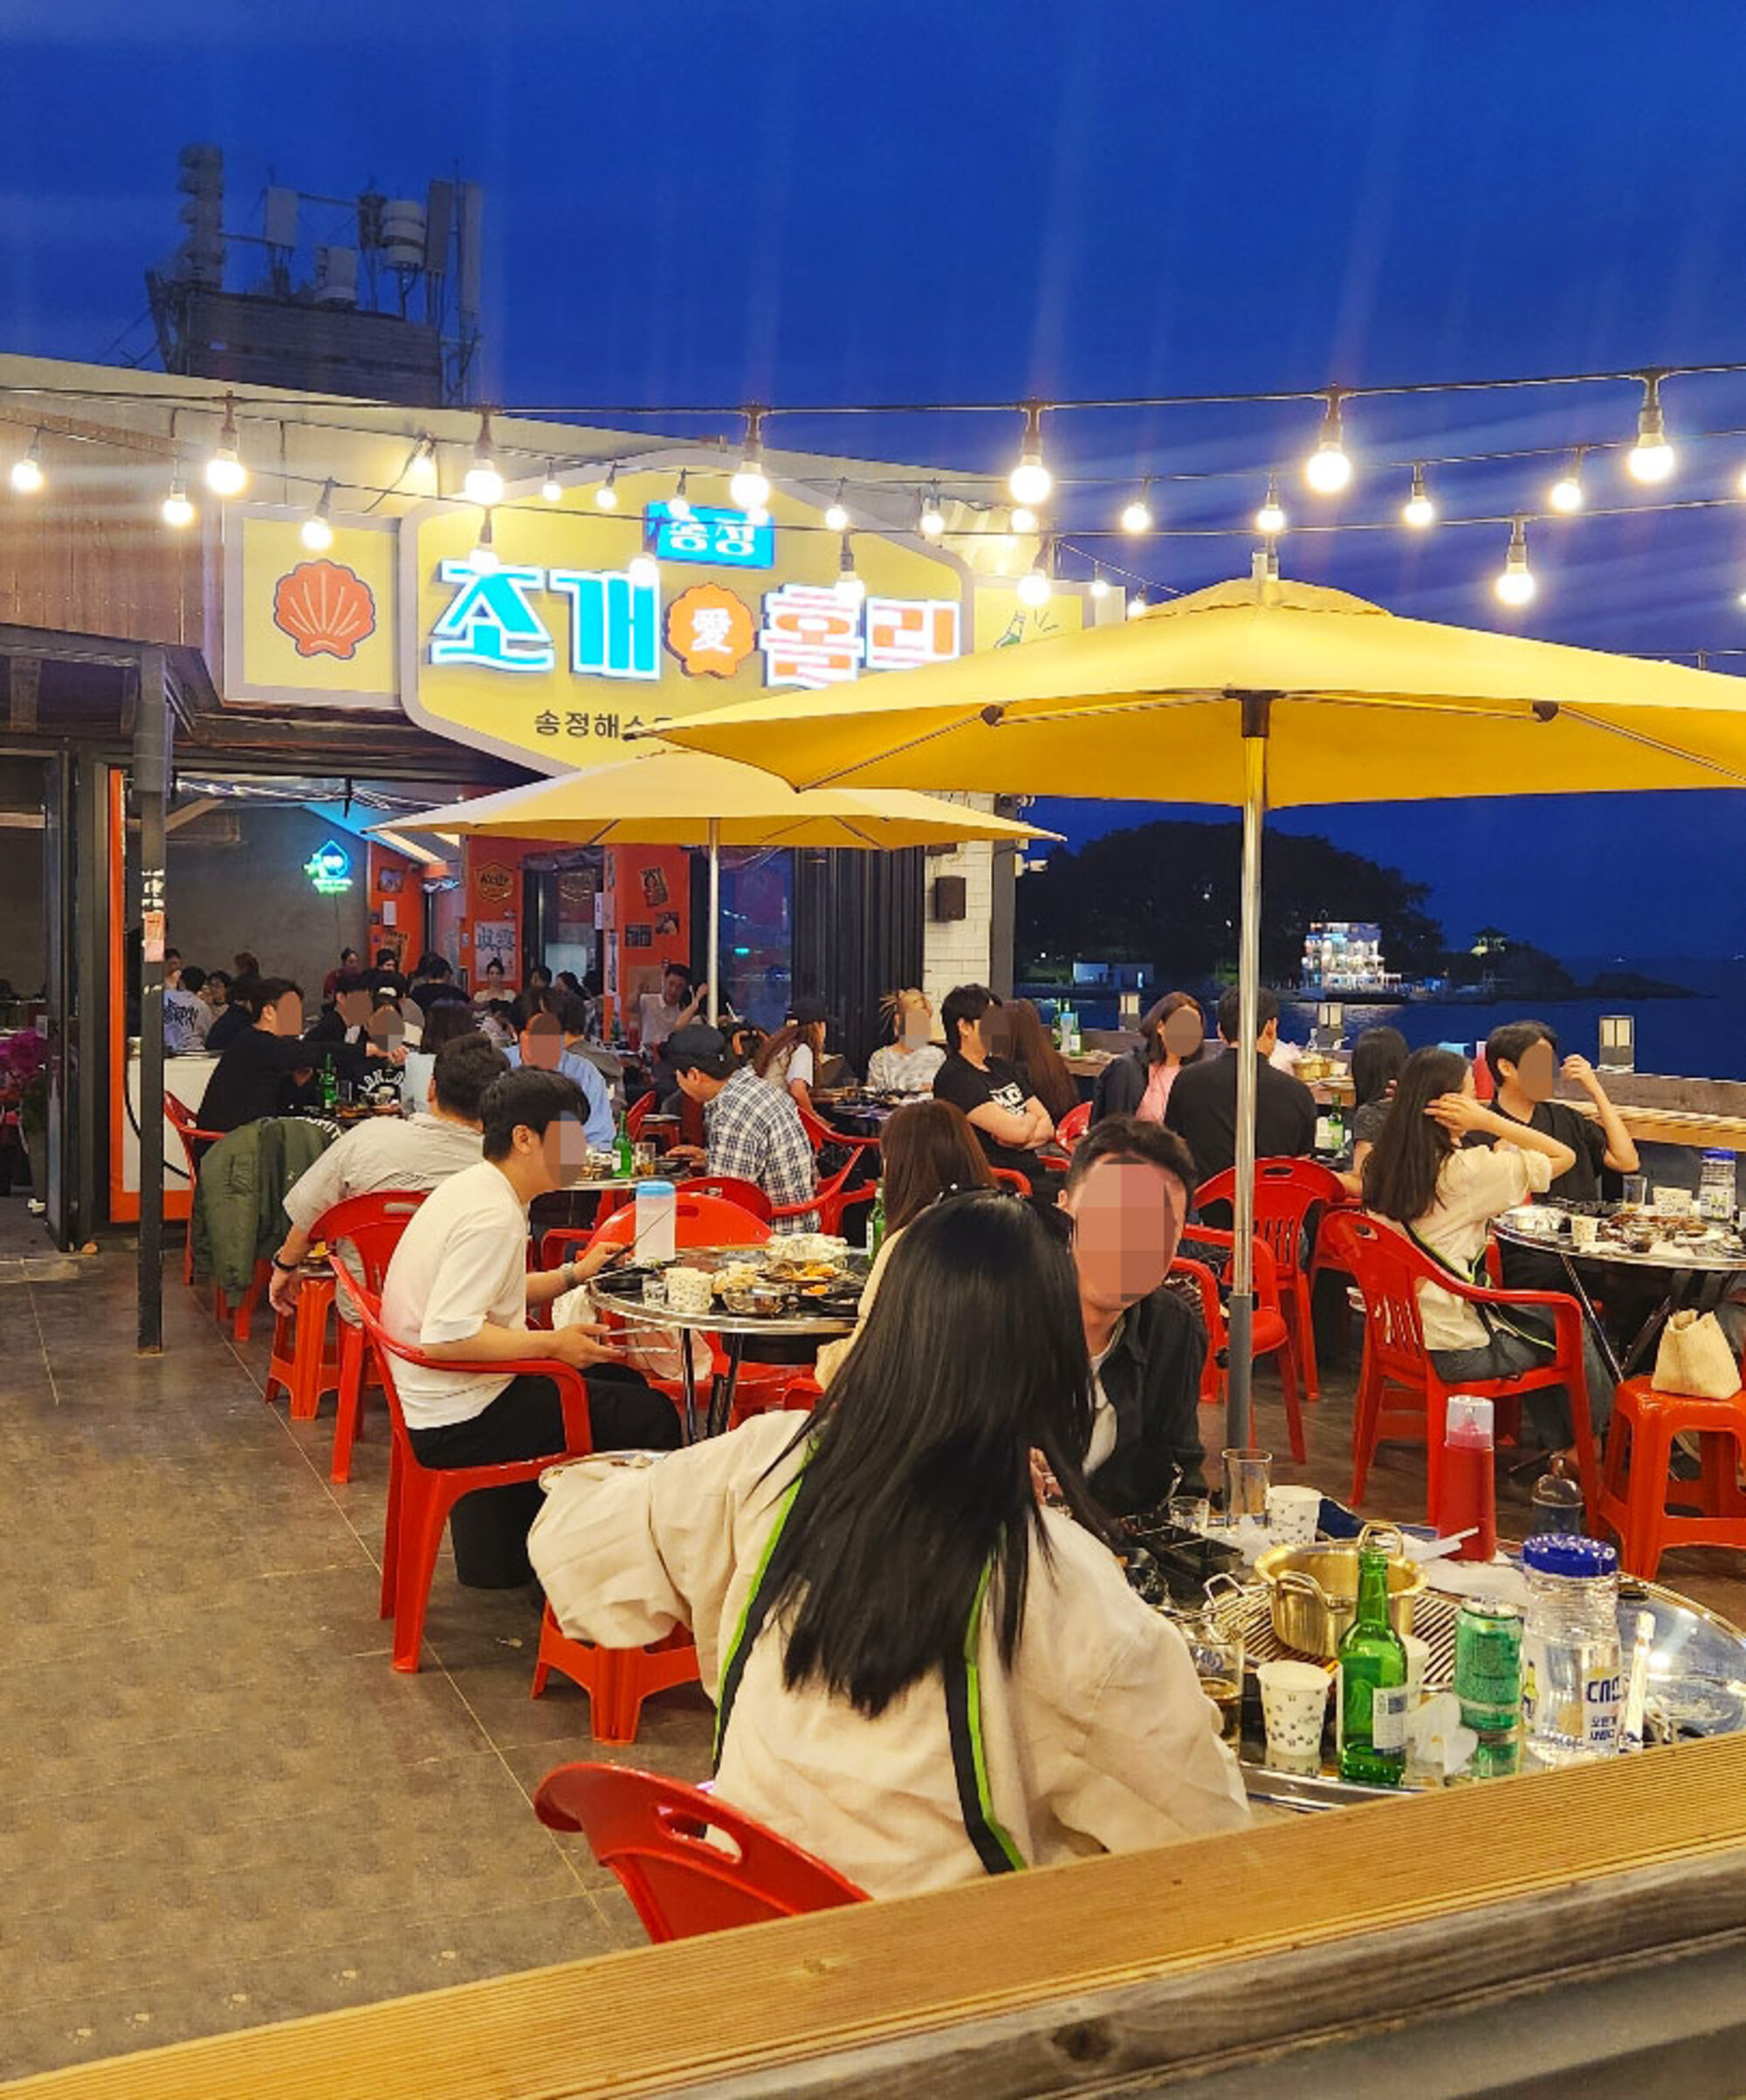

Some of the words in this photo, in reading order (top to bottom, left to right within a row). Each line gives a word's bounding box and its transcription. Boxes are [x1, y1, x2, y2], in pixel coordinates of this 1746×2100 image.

[668, 514, 756, 557] 송정
[430, 558, 661, 680] 조개
[690, 607, 733, 655] 愛
